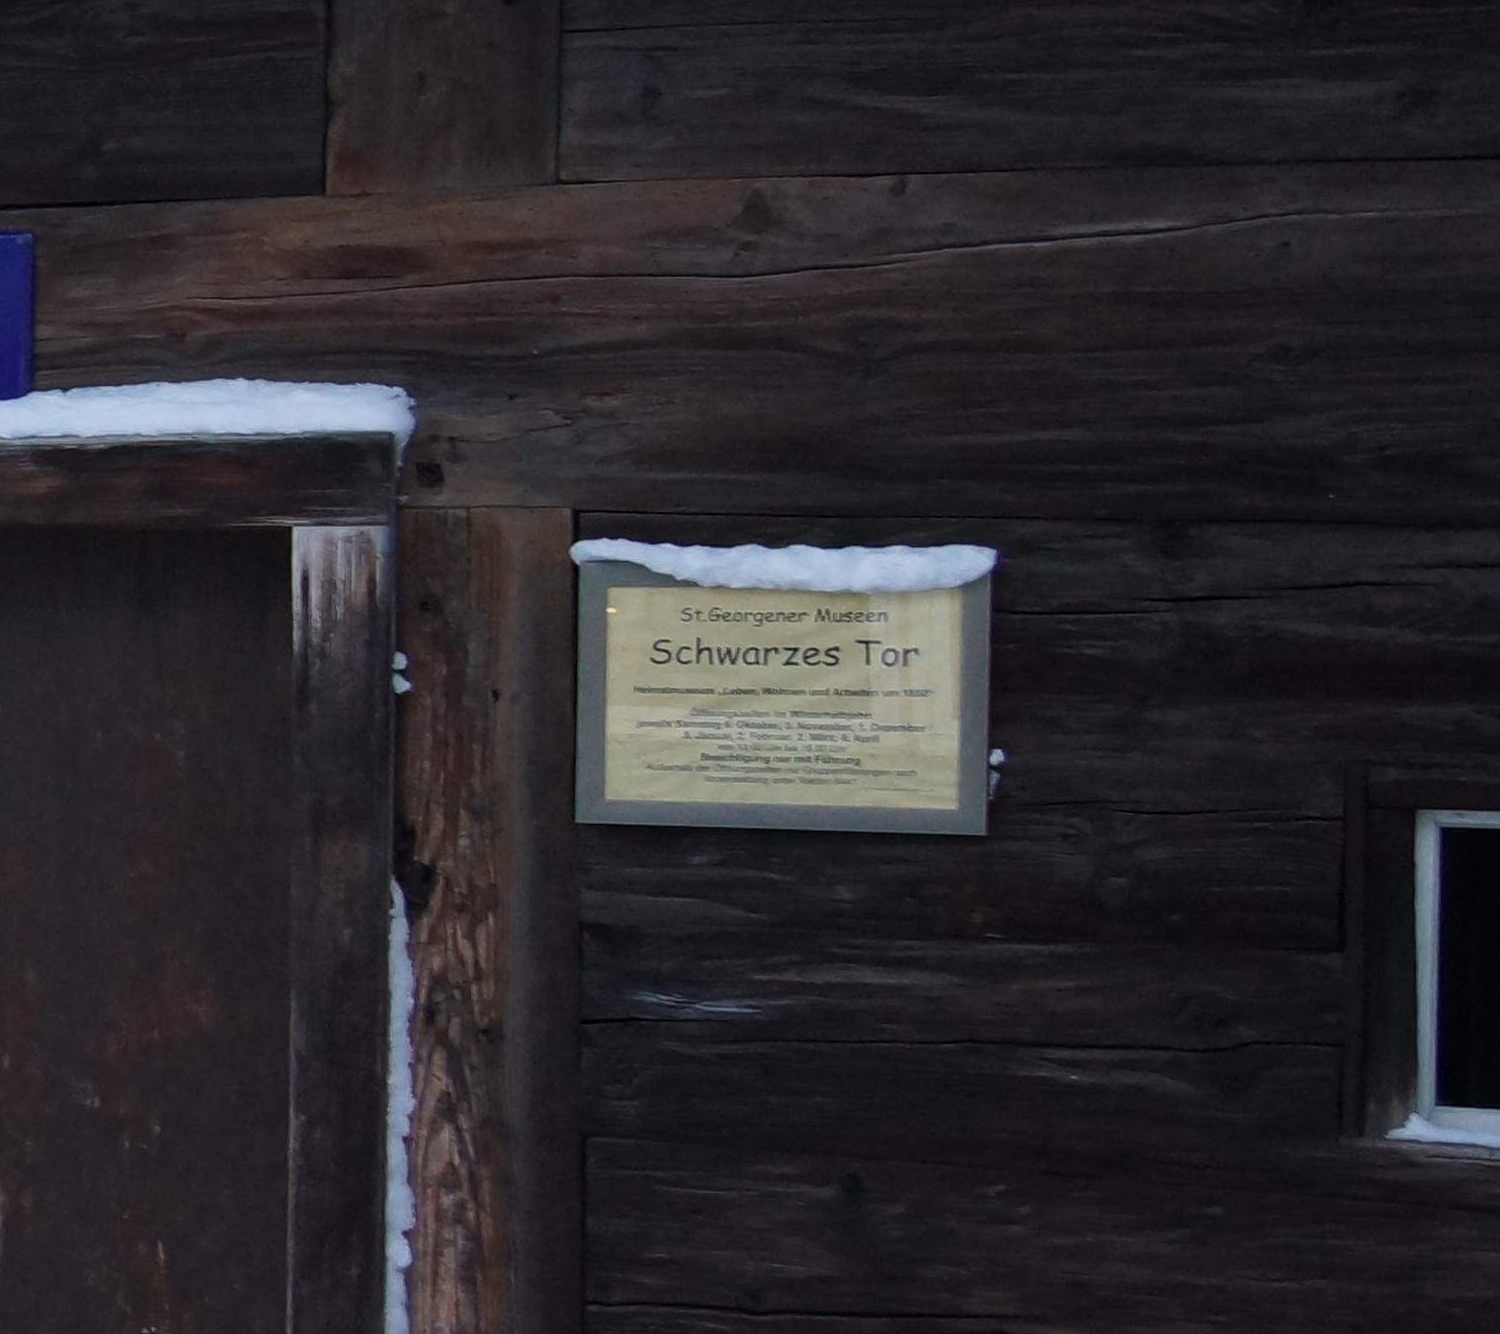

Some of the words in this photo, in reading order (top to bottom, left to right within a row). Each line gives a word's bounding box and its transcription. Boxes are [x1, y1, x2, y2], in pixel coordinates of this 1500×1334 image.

[814, 608, 889, 623] Museen
[650, 637, 841, 666] Schwarzes
[855, 639, 920, 667] Tor
